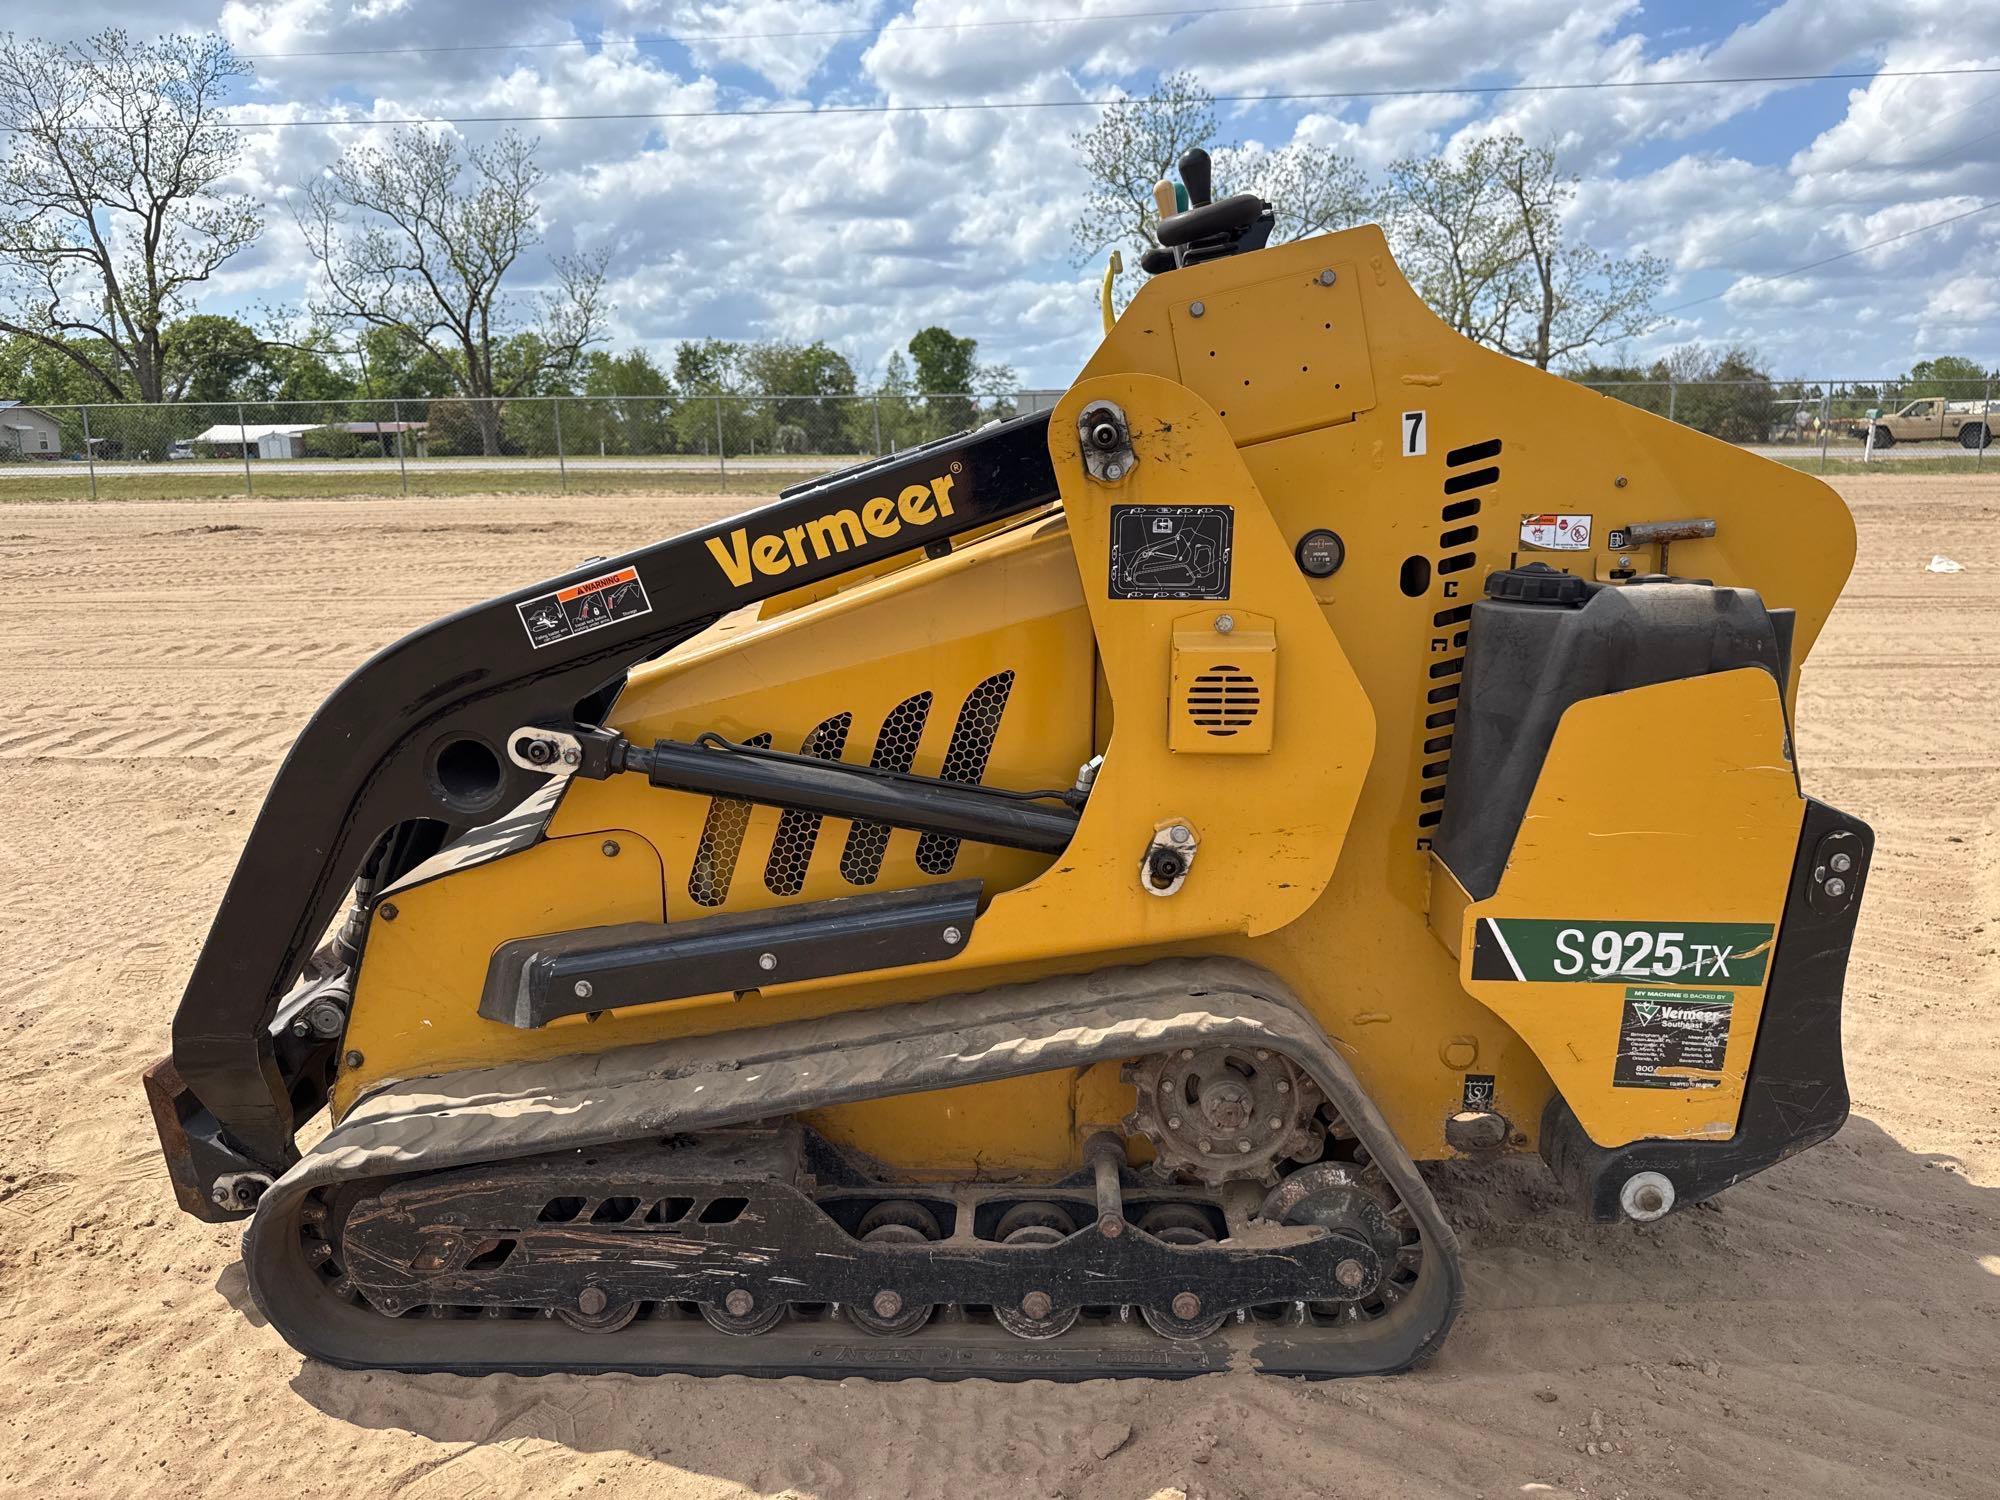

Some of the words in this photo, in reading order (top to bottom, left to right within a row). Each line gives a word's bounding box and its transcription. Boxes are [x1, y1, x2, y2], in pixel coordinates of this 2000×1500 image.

[1405, 412, 1423, 453] 7
[704, 473, 955, 588] Vermeer
[583, 575, 620, 593] WARNING
[1661, 1006, 1720, 1022] Vermeer
[1661, 1021, 1703, 1029] Southeast
